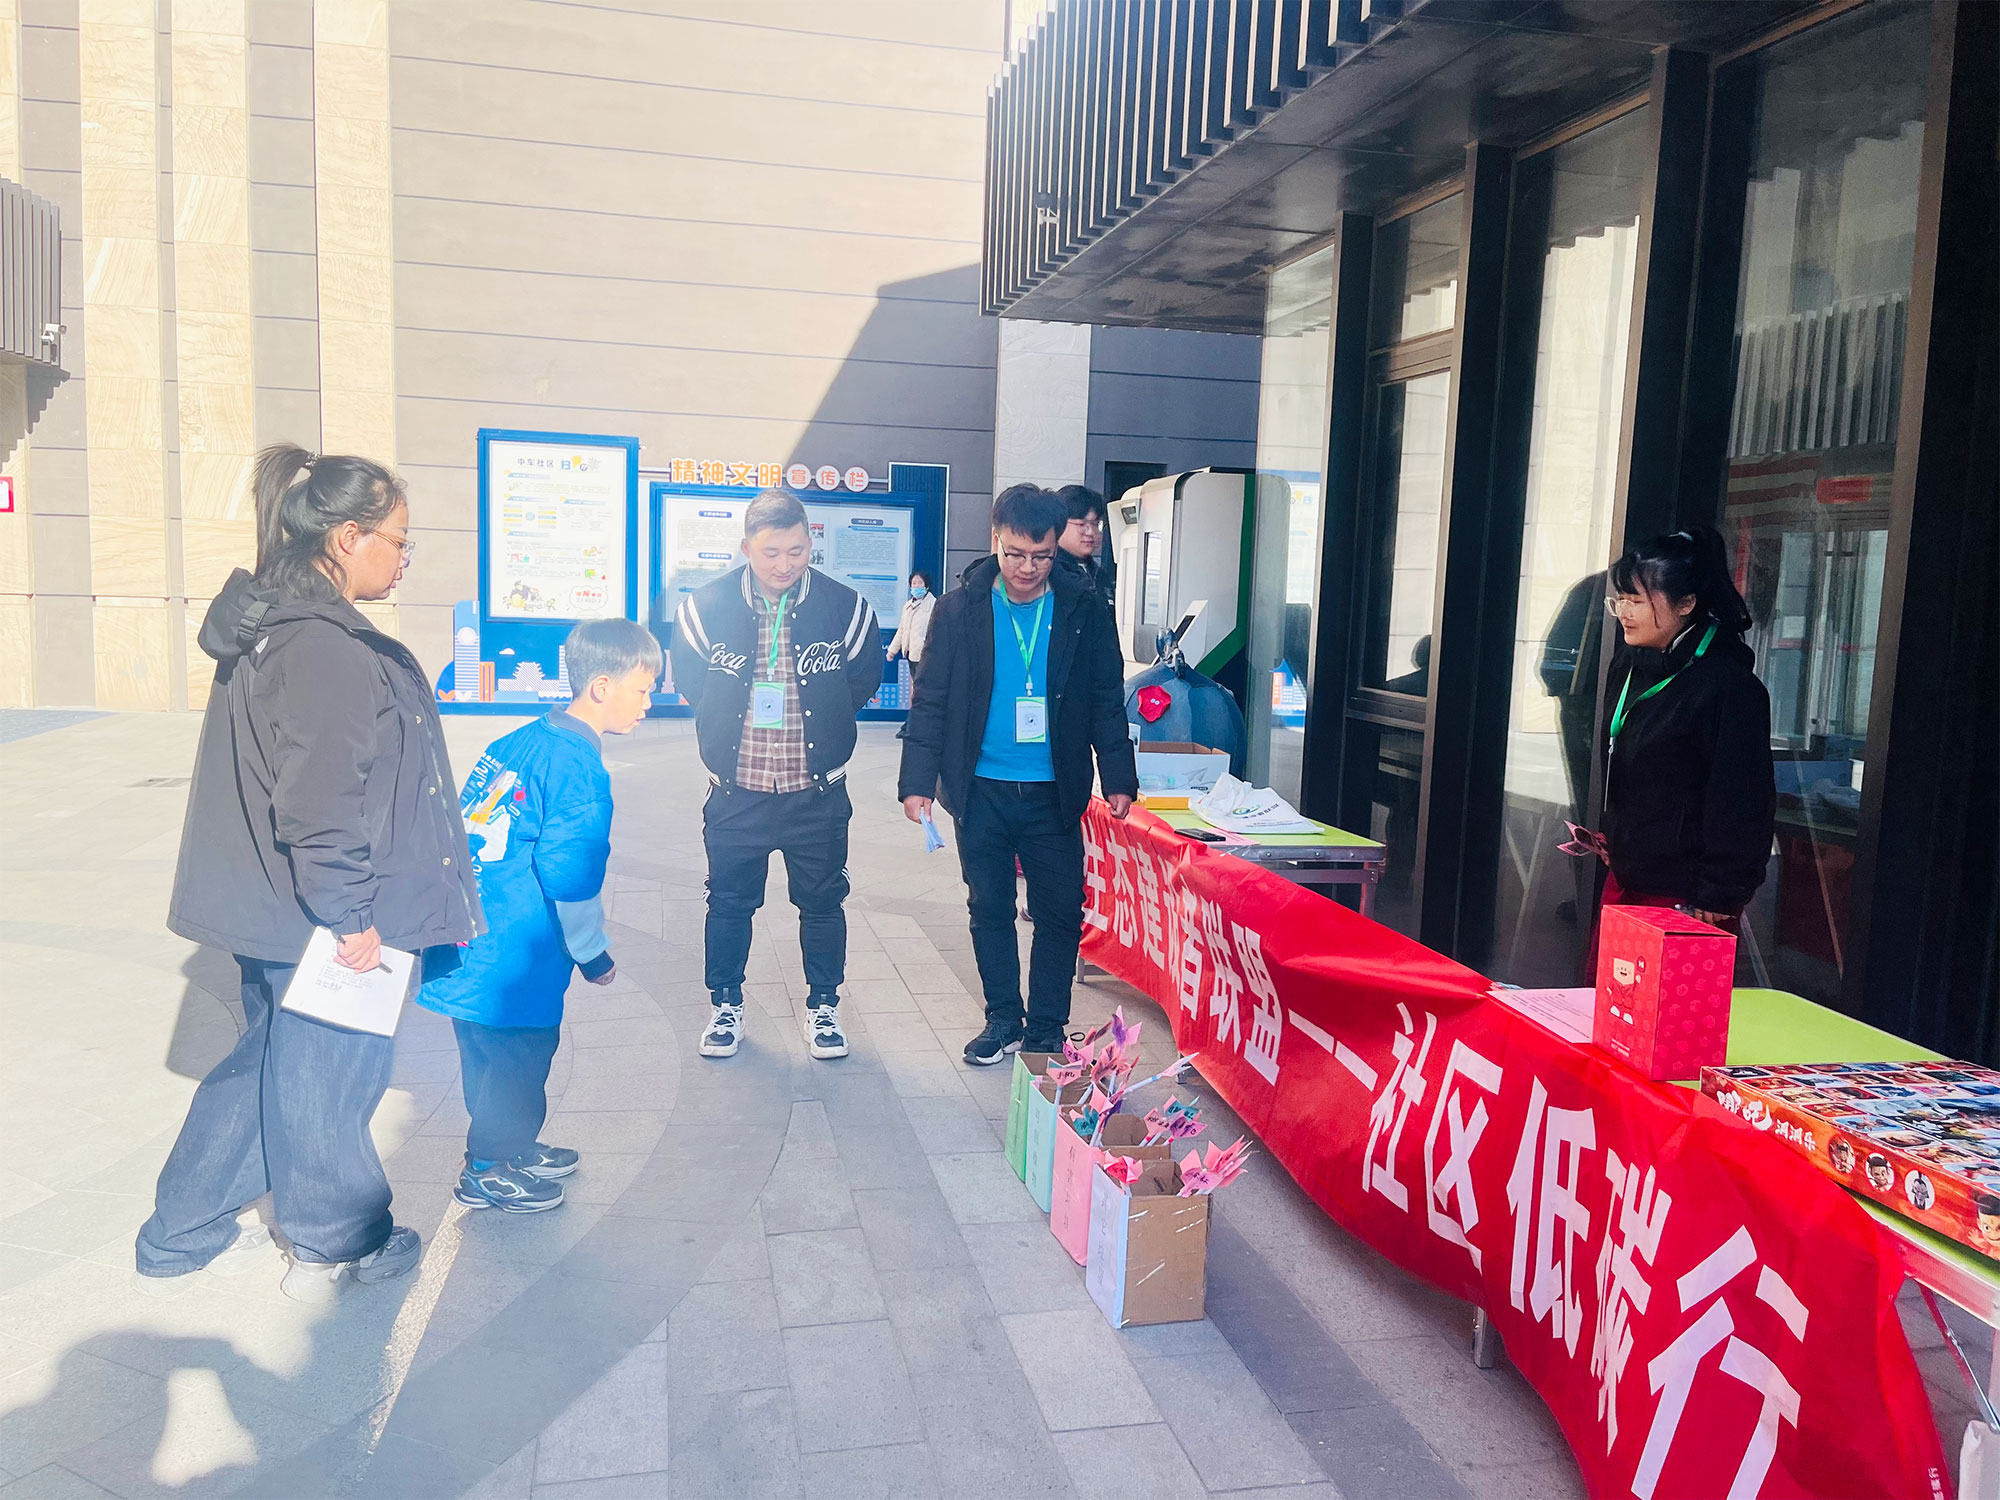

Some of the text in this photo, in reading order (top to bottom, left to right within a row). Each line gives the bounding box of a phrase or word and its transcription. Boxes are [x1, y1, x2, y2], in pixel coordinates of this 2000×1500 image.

[670, 458, 867, 490] 精神文明宣传栏
[797, 640, 845, 677] Cola
